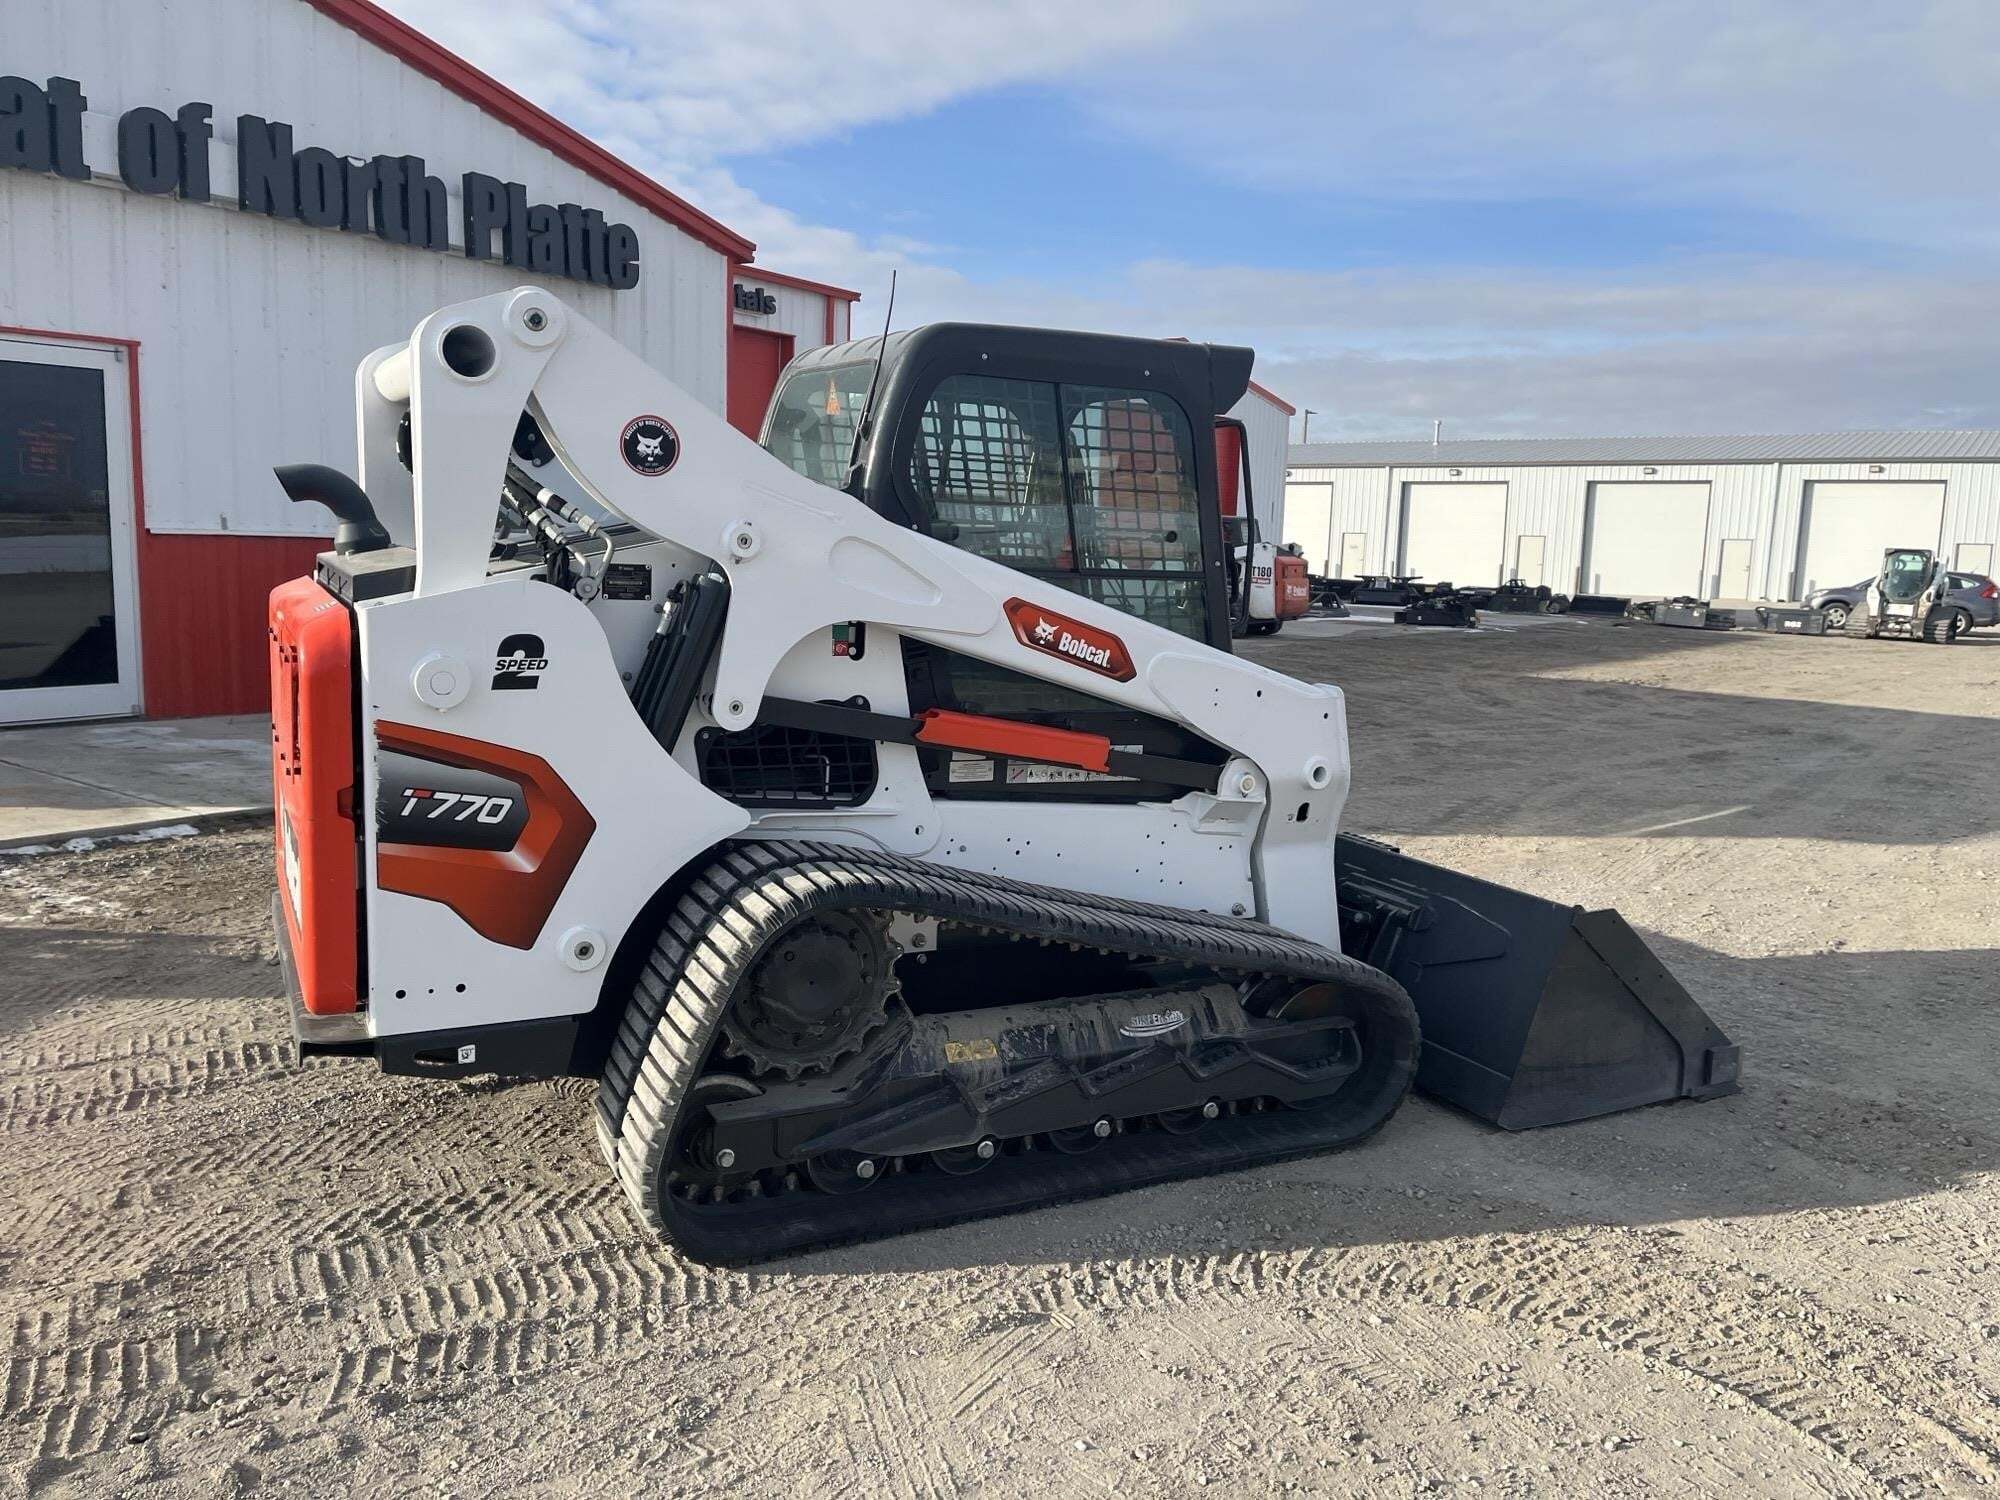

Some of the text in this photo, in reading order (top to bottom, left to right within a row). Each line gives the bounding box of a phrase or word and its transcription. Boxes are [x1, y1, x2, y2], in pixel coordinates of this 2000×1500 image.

[118, 102, 212, 202] of
[237, 114, 448, 251] North
[463, 171, 640, 290] Platte
[494, 658, 549, 671] SPEED
[1057, 631, 1110, 668] Bobcat
[400, 788, 514, 824] T770
